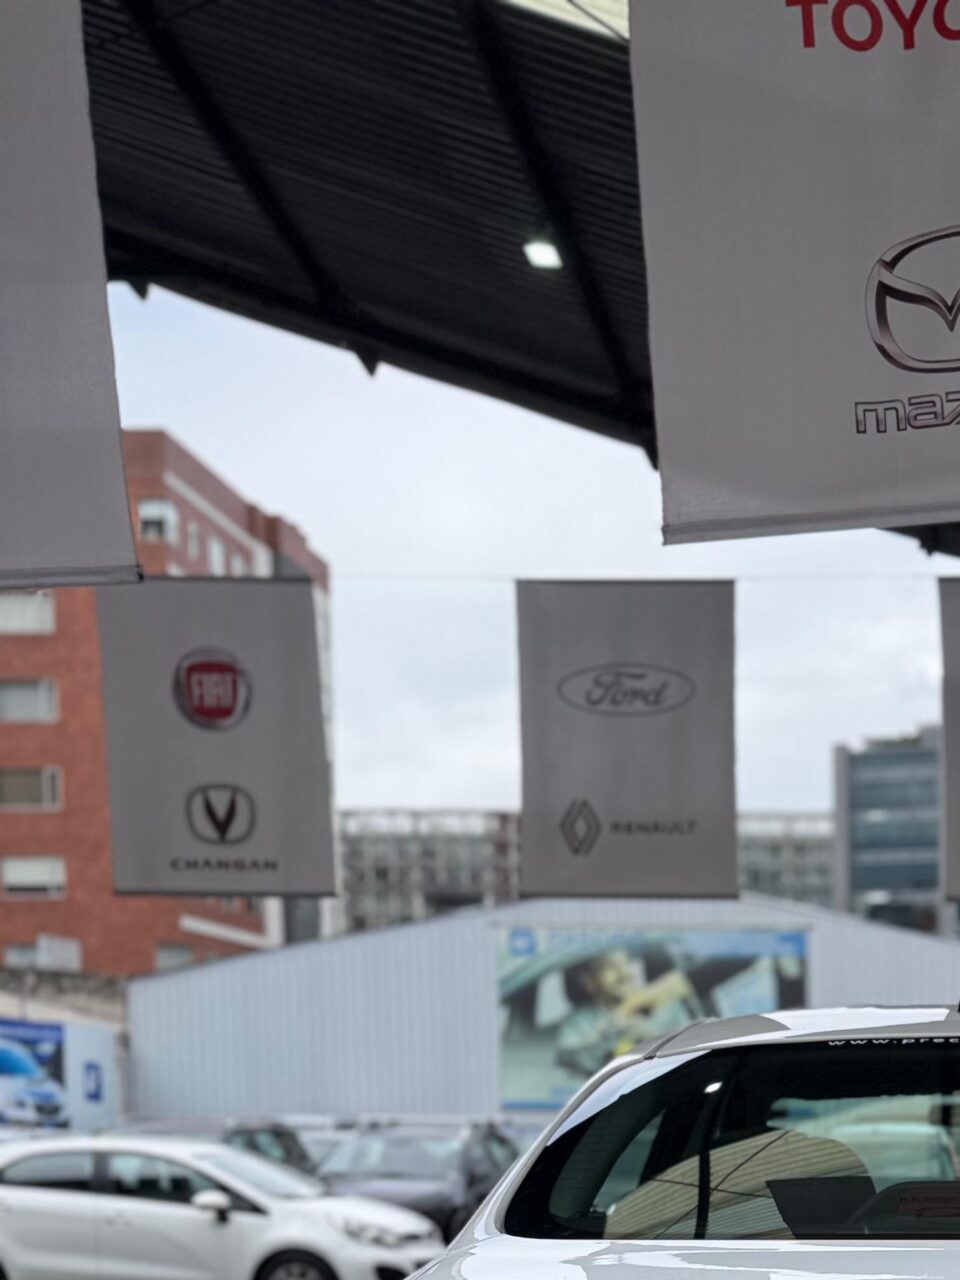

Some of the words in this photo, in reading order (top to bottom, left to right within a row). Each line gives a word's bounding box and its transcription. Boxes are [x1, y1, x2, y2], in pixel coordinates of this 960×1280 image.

[192, 671, 235, 709] FIAT
[586, 670, 669, 706] Ford
[610, 820, 697, 835] RENAULT
[170, 857, 279, 872] CHANGAN
